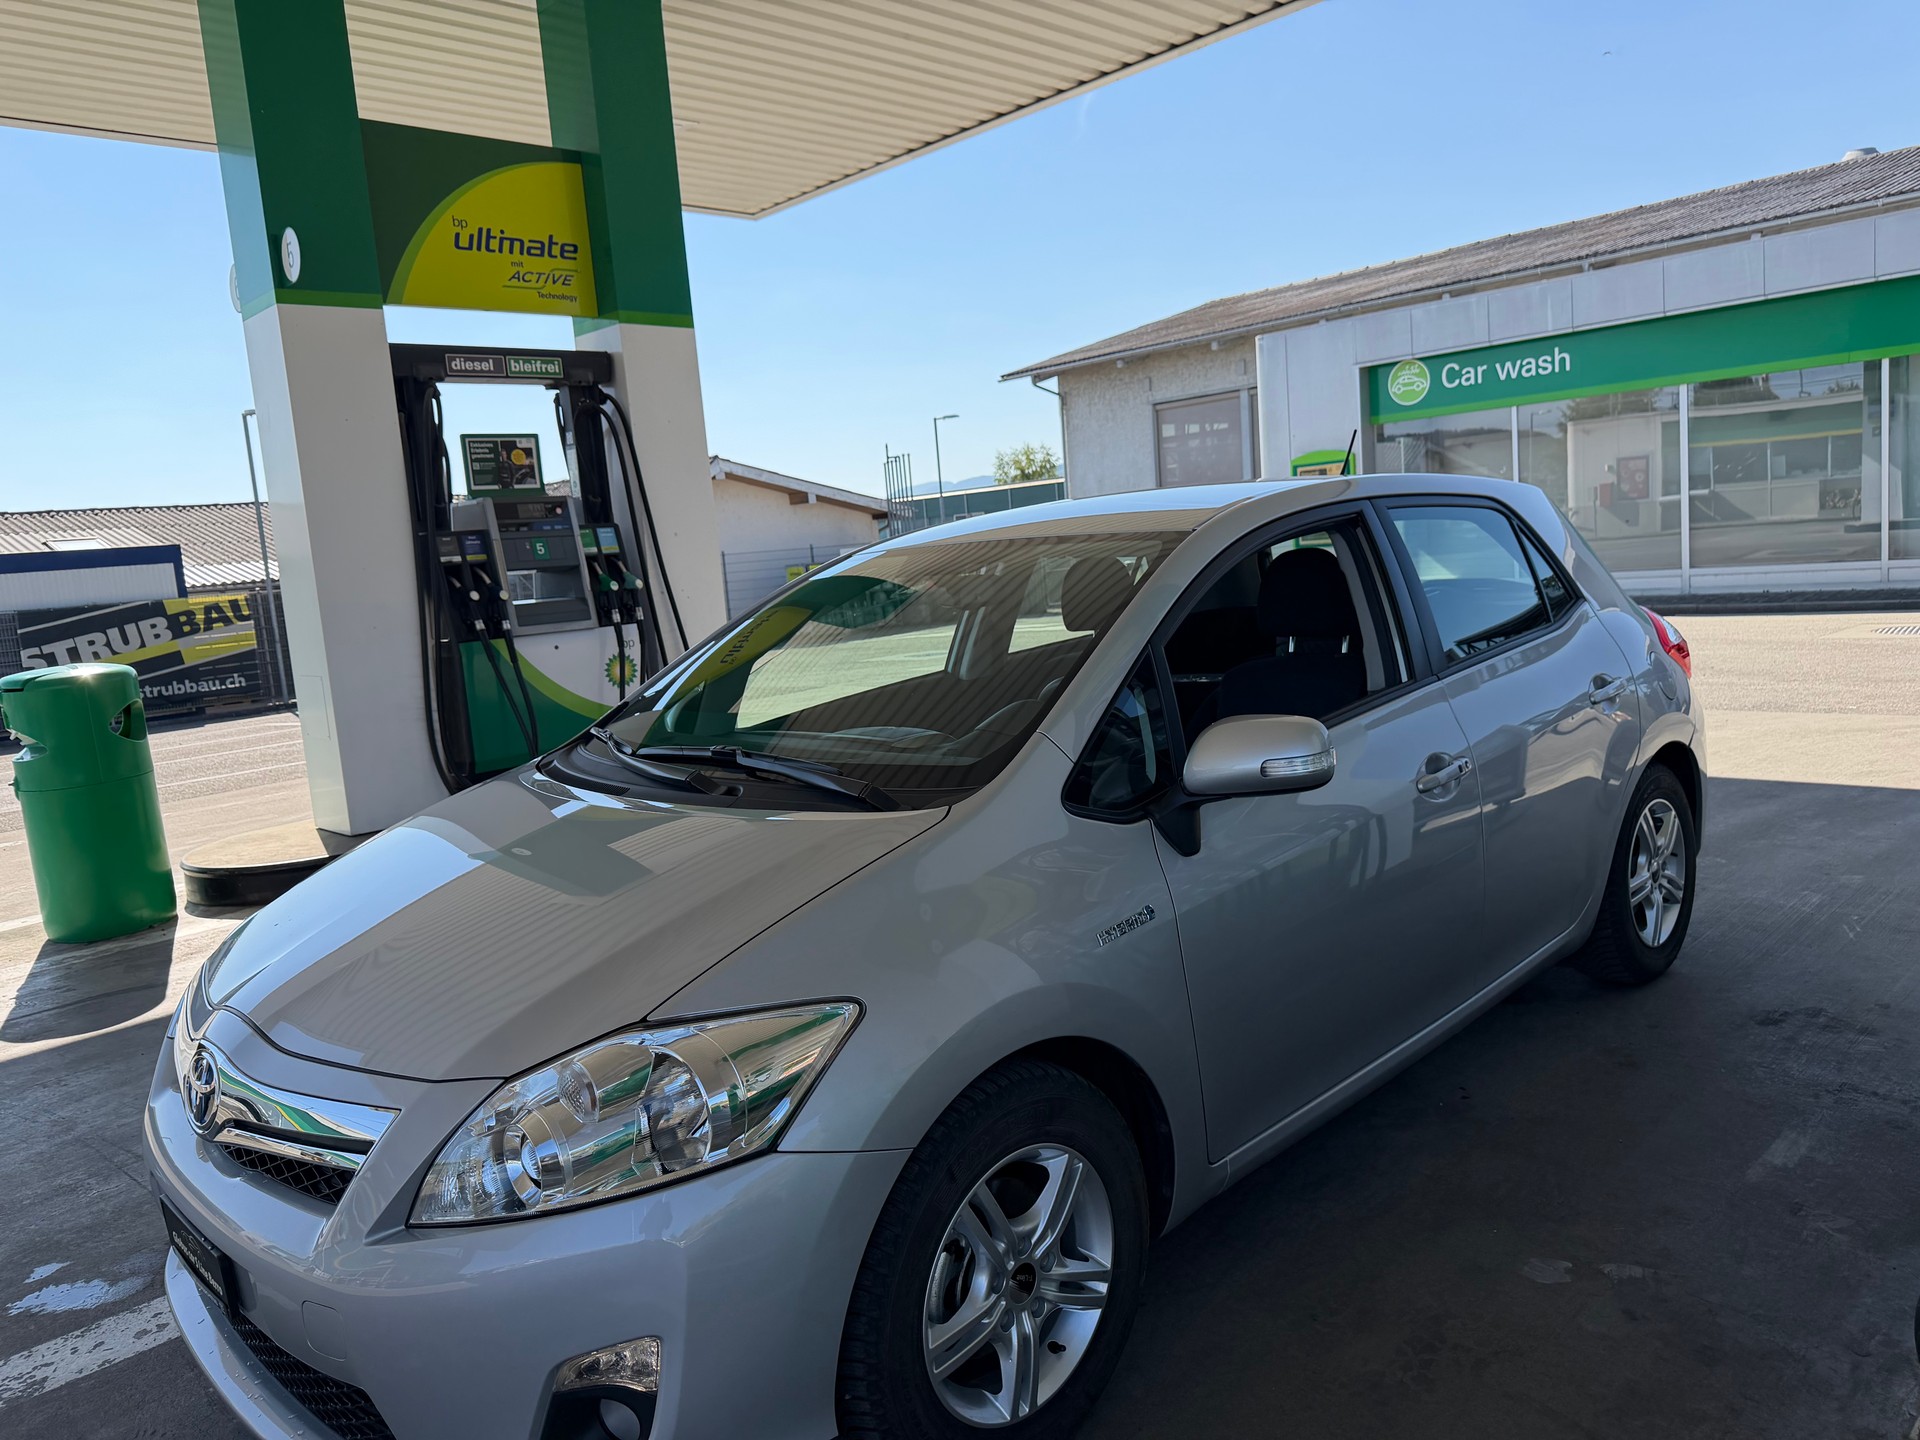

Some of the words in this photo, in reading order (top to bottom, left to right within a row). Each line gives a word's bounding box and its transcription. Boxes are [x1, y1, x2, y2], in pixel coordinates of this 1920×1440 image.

[452, 215, 468, 230] bp
[454, 227, 579, 260] ultimate
[286, 241, 295, 269] 5
[508, 270, 574, 287] ACTIVE
[537, 291, 578, 303] Technology
[451, 358, 494, 371] diesel
[510, 359, 560, 373] bleifrei
[1441, 362, 1487, 389] Car
[1495, 346, 1571, 381] wash
[536, 543, 545, 555] 5
